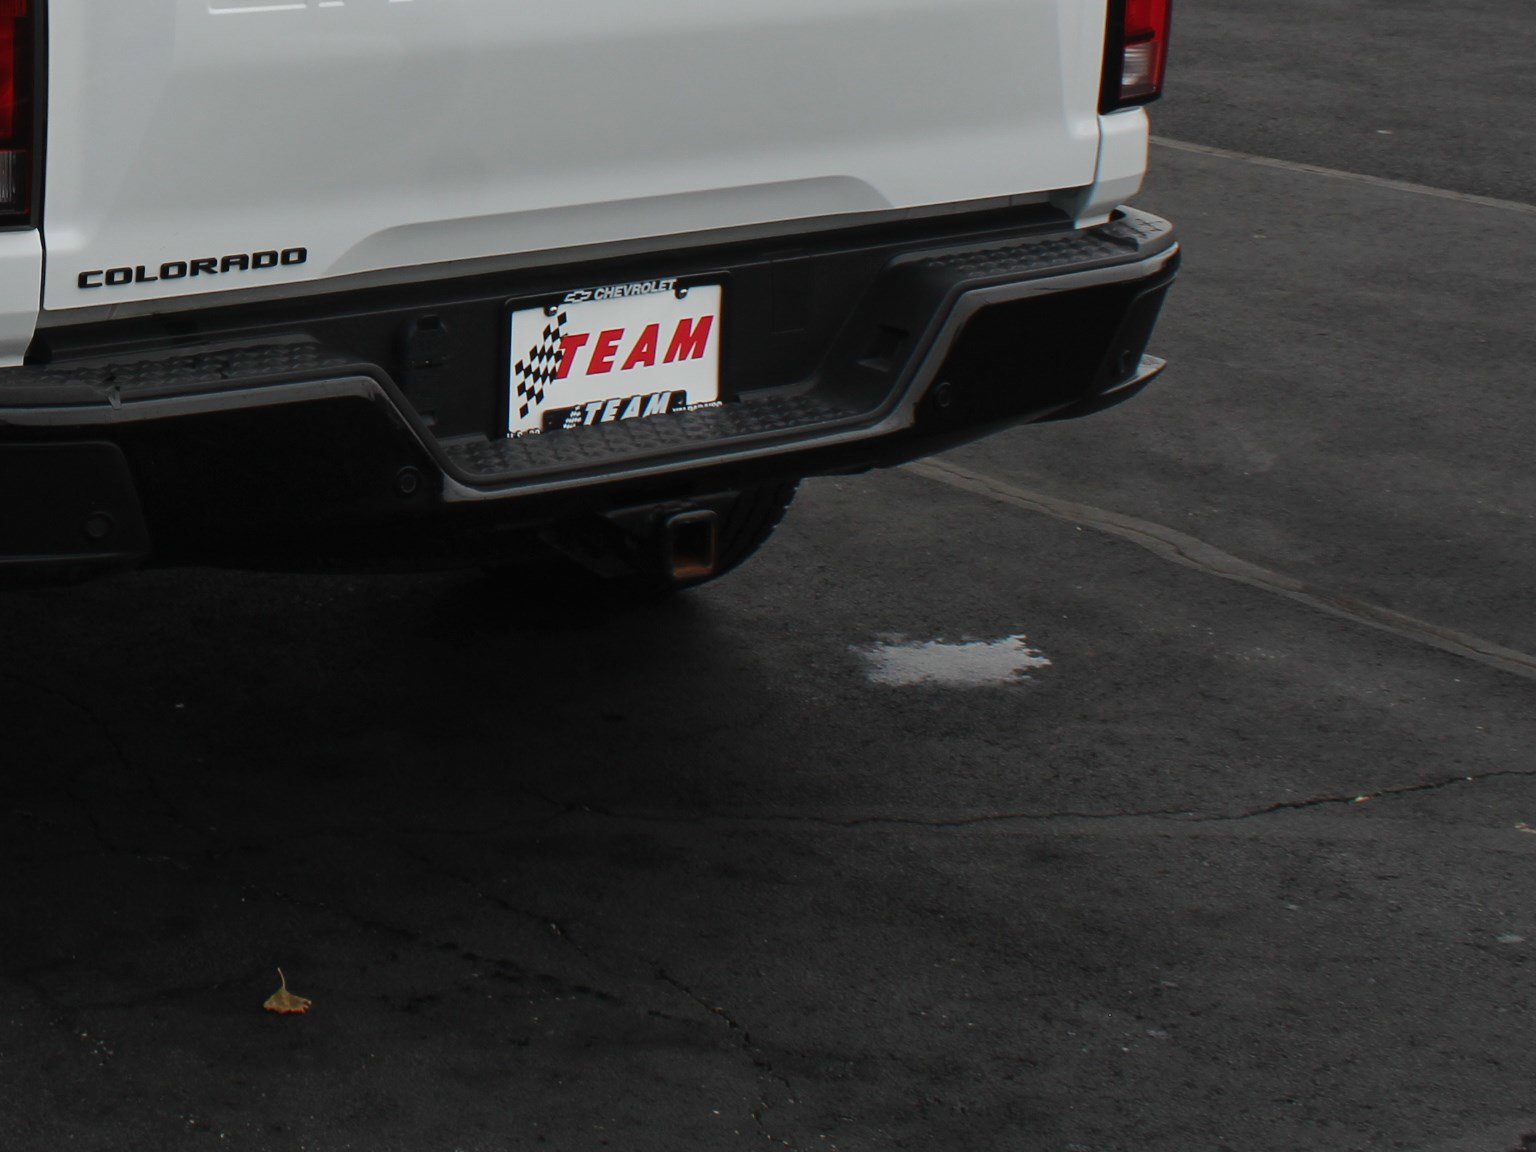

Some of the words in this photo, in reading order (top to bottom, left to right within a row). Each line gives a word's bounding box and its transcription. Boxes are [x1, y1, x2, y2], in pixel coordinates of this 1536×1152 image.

[77, 247, 308, 289] COLORADO
[594, 279, 677, 301] CHEVROLET
[555, 315, 714, 380] TEAM
[583, 391, 672, 426] TEAM
